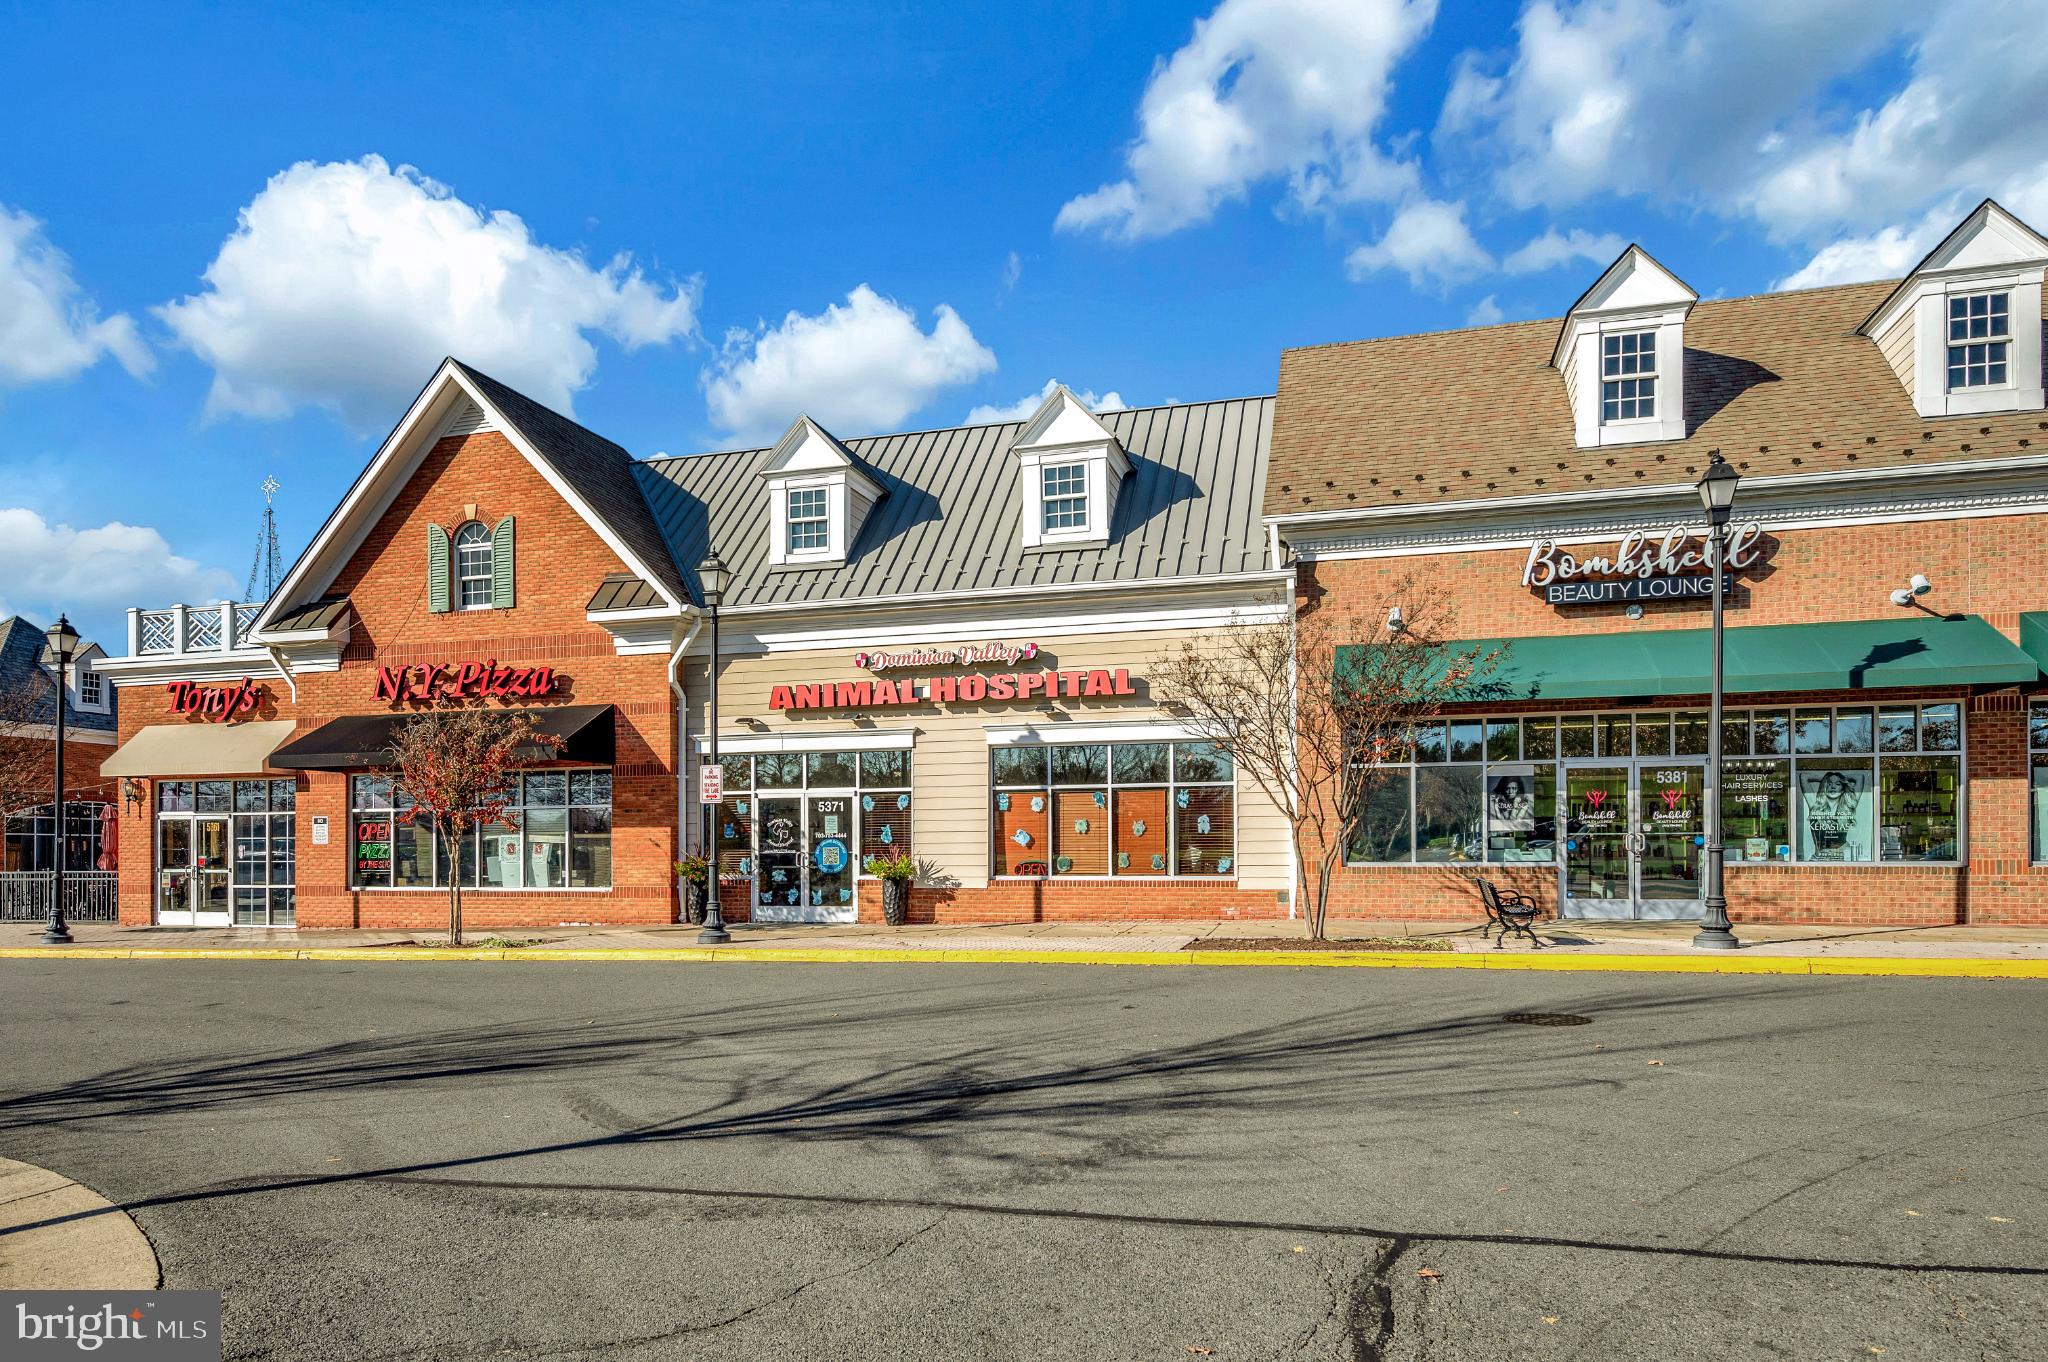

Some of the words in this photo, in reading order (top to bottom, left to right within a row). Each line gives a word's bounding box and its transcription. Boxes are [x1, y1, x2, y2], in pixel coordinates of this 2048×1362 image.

[1520, 521, 1762, 586] Bombshell
[1549, 581, 1633, 602] BEAUTY
[1638, 575, 1728, 598] LOUNGE
[869, 647, 955, 671] Dominion
[958, 641, 1022, 666] Valley
[451, 658, 555, 698] Pizza
[769, 679, 919, 710] ANIMAL
[929, 669, 1136, 702] HOSPITAL
[166, 675, 257, 724] Tony's
[1656, 771, 1688, 784] 5381
[1742, 781, 1784, 789] SERVICES
[818, 801, 844, 812] 5371
[358, 822, 391, 840] OPEN
[1014, 862, 1048, 876] OPEN
